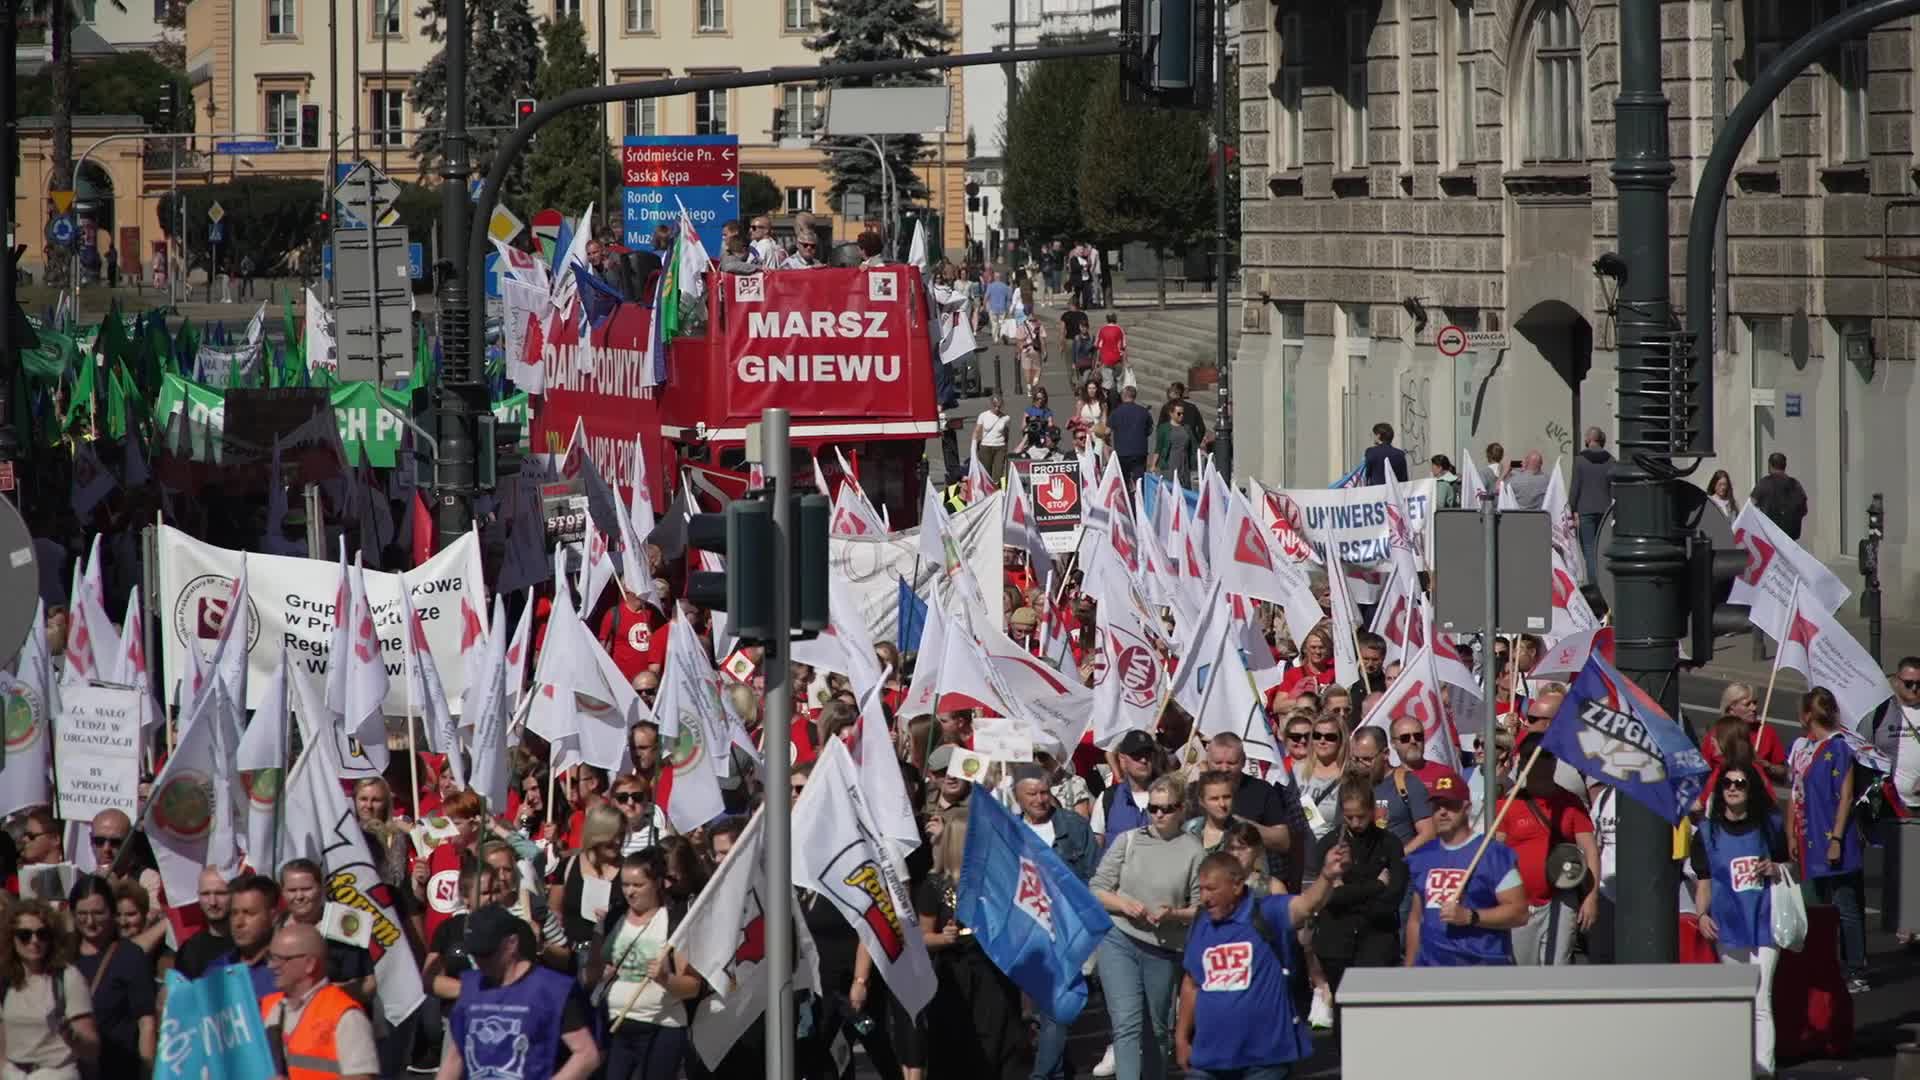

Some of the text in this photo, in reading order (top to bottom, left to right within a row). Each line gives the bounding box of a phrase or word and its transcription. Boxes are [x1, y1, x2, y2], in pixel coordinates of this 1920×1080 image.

[627, 147, 716, 162] Śródmieście Pn.
[627, 170, 689, 185] Saska Kępa
[627, 191, 663, 203] Rondo
[628, 208, 638, 220] R.
[749, 312, 888, 338] MARSZ
[1467, 333, 1505, 341] UWAGA
[737, 355, 900, 382] GNIEWU
[1033, 463, 1078, 474] PROTEST
[1046, 501, 1069, 509] STOP
[548, 514, 585, 529] STOP
[63, 733, 133, 747] ORGANIZACJI
[90, 767, 103, 777] BY
